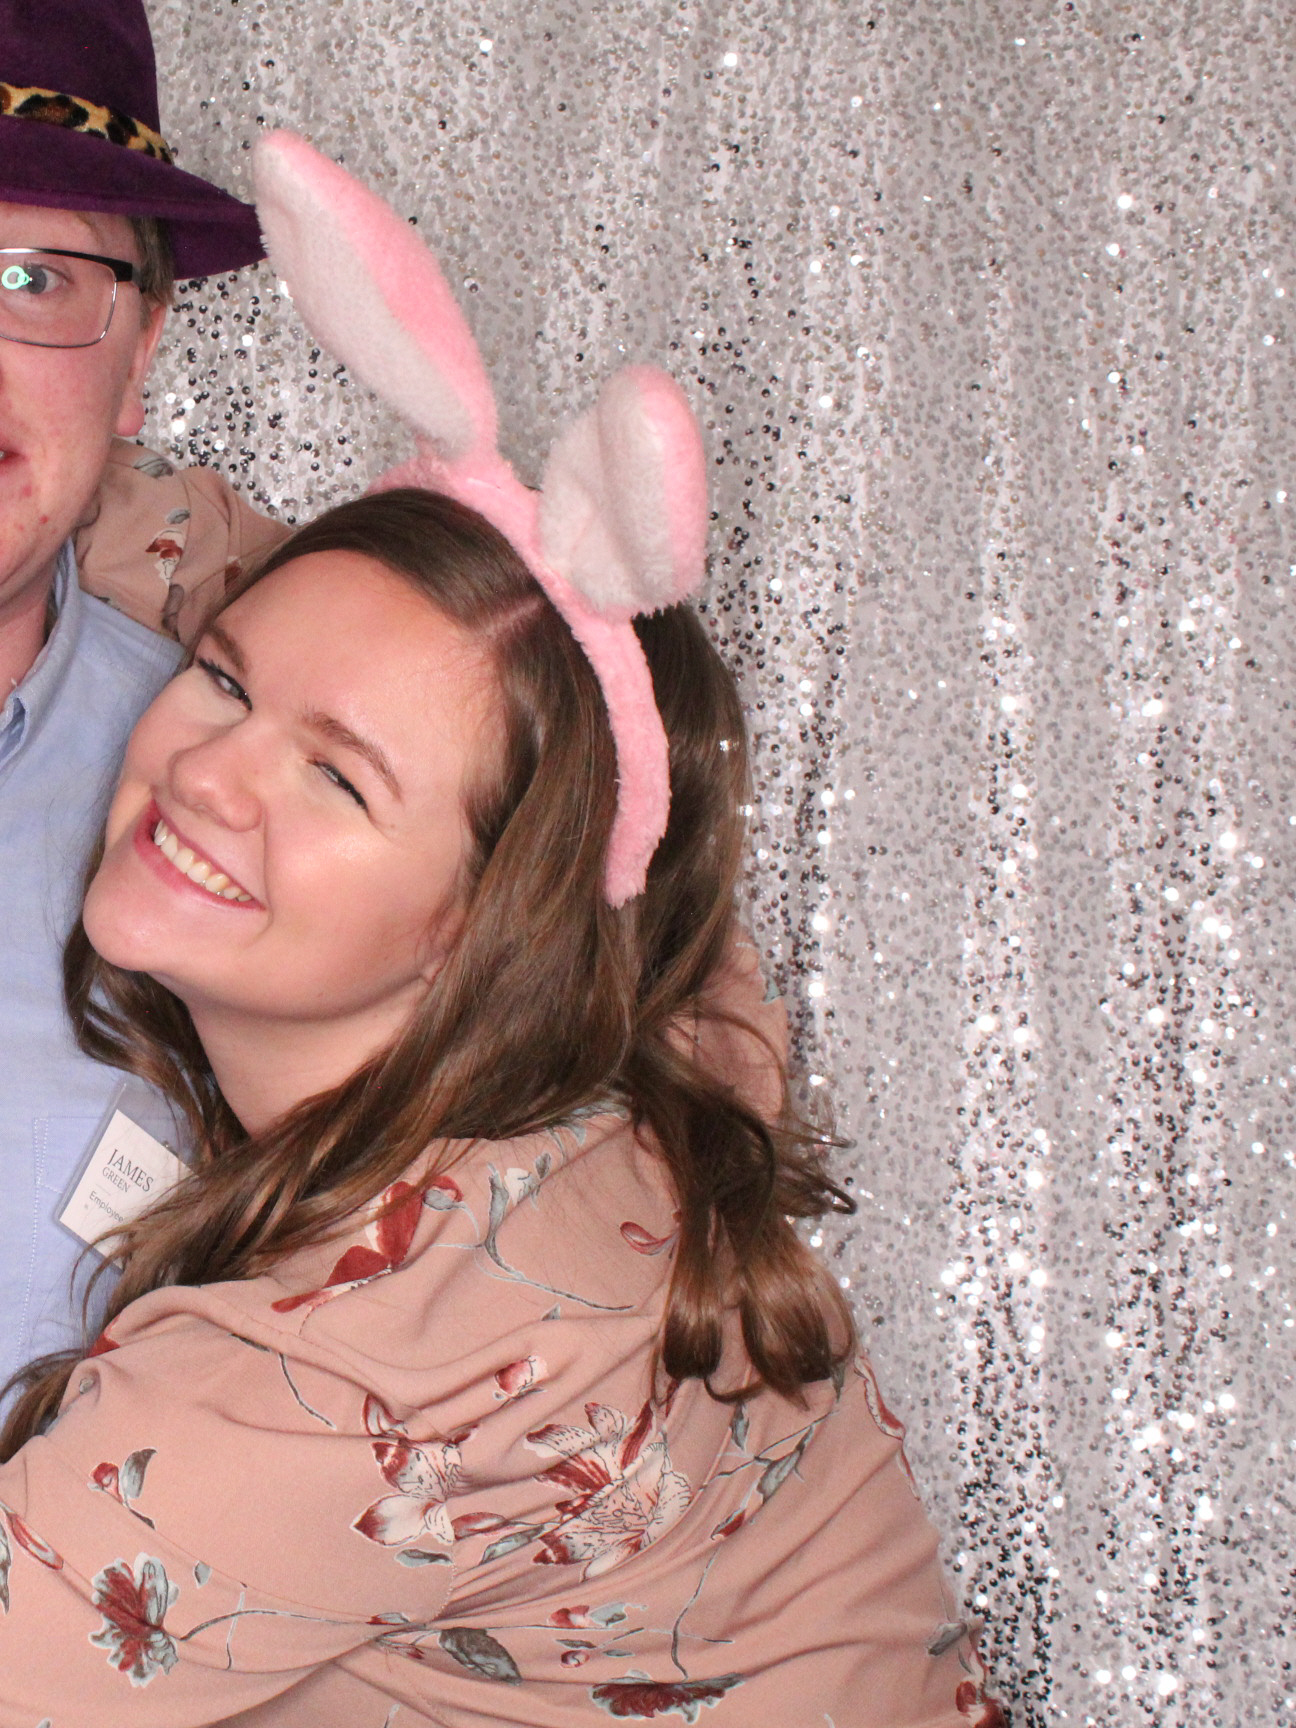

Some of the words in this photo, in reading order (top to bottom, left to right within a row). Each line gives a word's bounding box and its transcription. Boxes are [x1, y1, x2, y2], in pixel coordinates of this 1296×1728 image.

[102, 1166, 130, 1193] GREEN
[107, 1149, 154, 1192] JAMES
[89, 1190, 124, 1223] Employee
